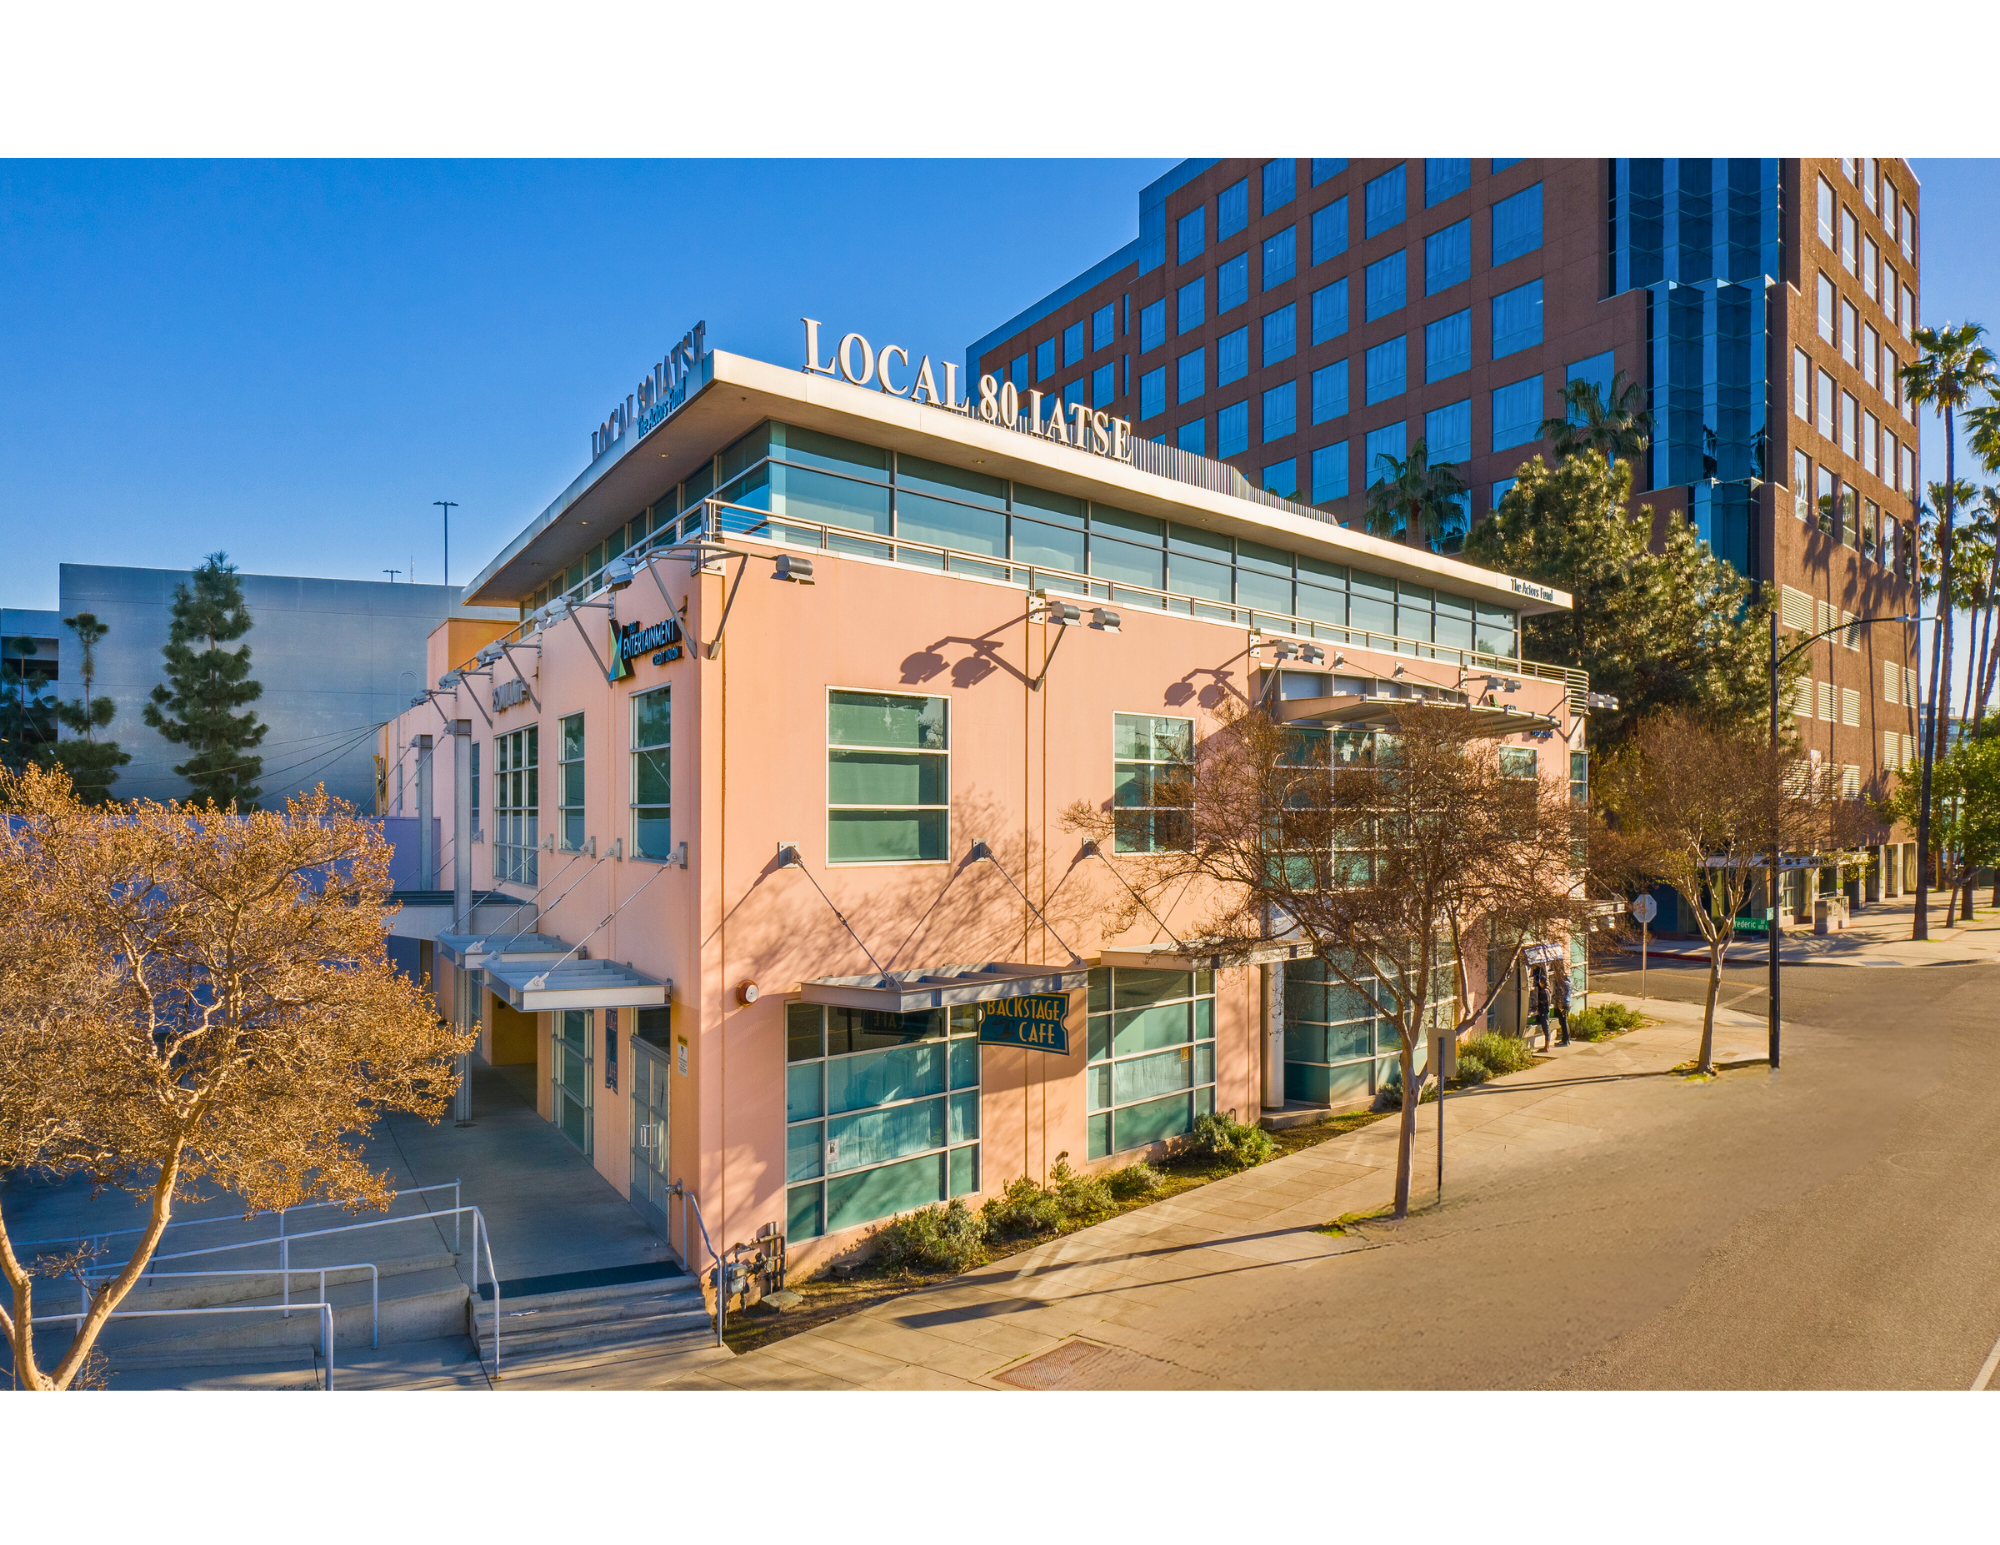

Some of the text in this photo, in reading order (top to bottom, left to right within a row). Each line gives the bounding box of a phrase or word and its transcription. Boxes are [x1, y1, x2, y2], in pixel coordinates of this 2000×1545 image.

[801, 317, 1132, 463] LOCAL 80 IATSE
[1511, 579, 1553, 601] The Actors Fund
[623, 617, 675, 659] ENTERTAINMENT
[1733, 919, 1757, 929] rederic
[986, 997, 1060, 1021] BACKSTAGE
[1018, 1022, 1055, 1044] CAFE
